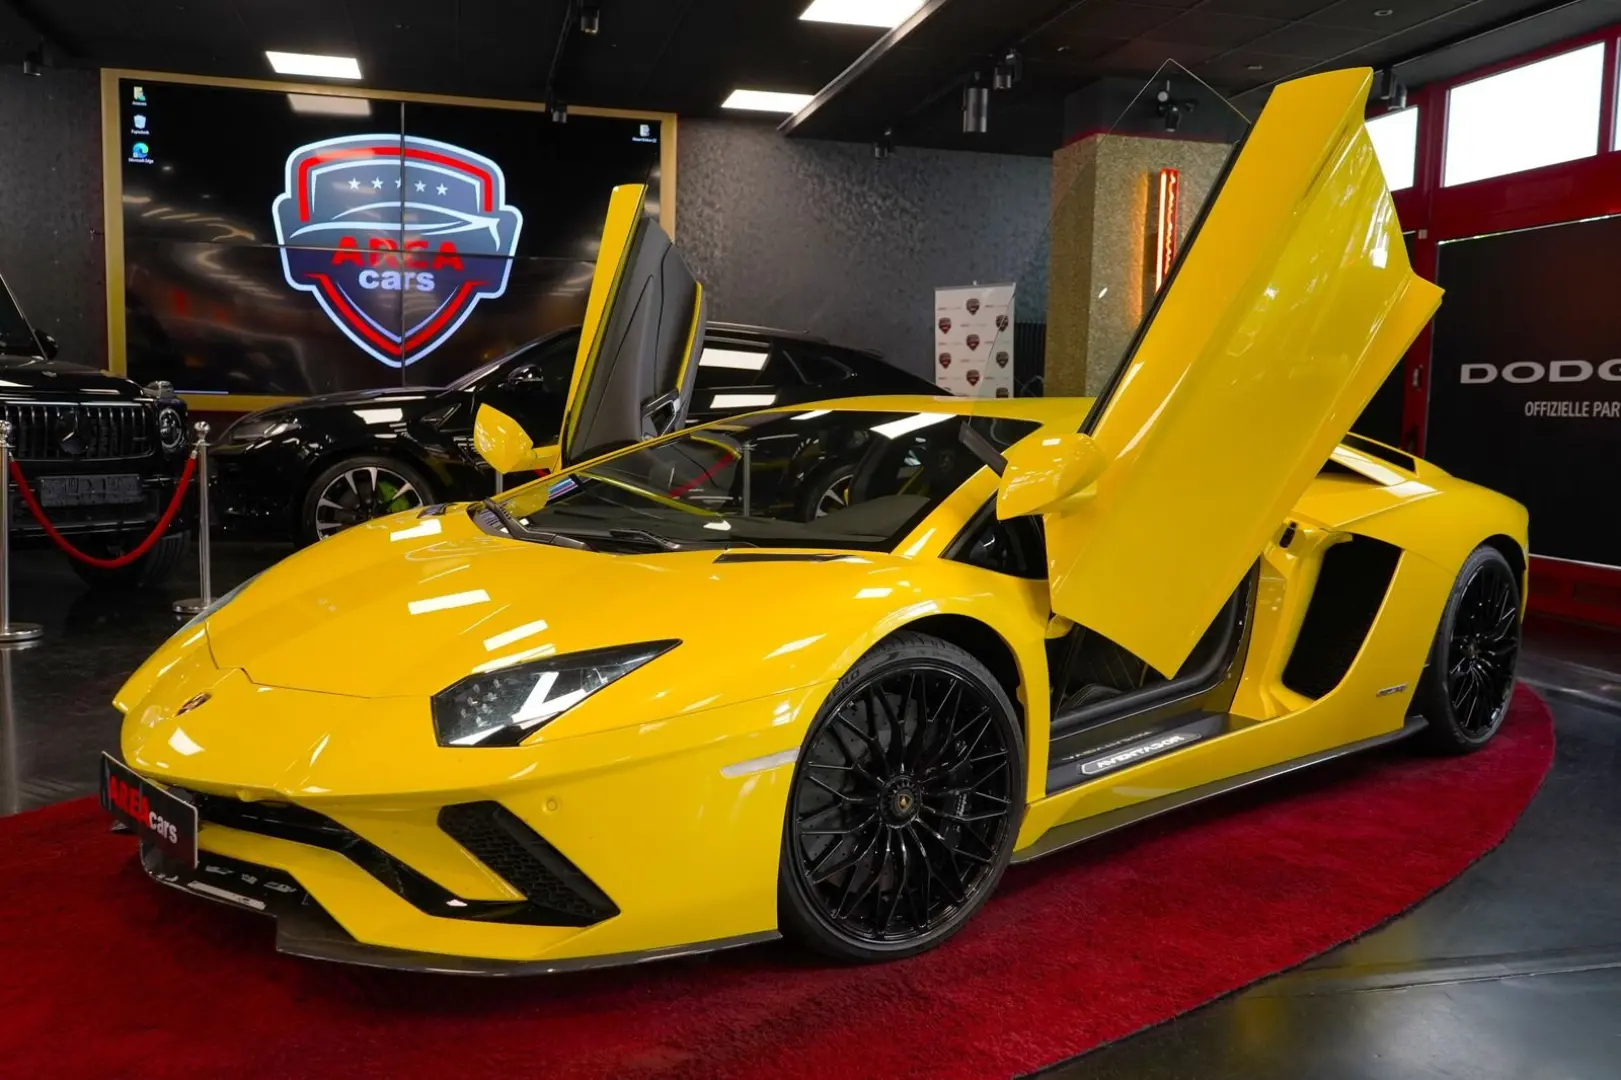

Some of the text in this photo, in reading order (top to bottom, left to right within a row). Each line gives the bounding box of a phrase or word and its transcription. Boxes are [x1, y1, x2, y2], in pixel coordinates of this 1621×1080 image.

[331, 236, 464, 271] AREA
[358, 269, 435, 291] cars
[1525, 401, 1590, 417] OFFIZIELLE
